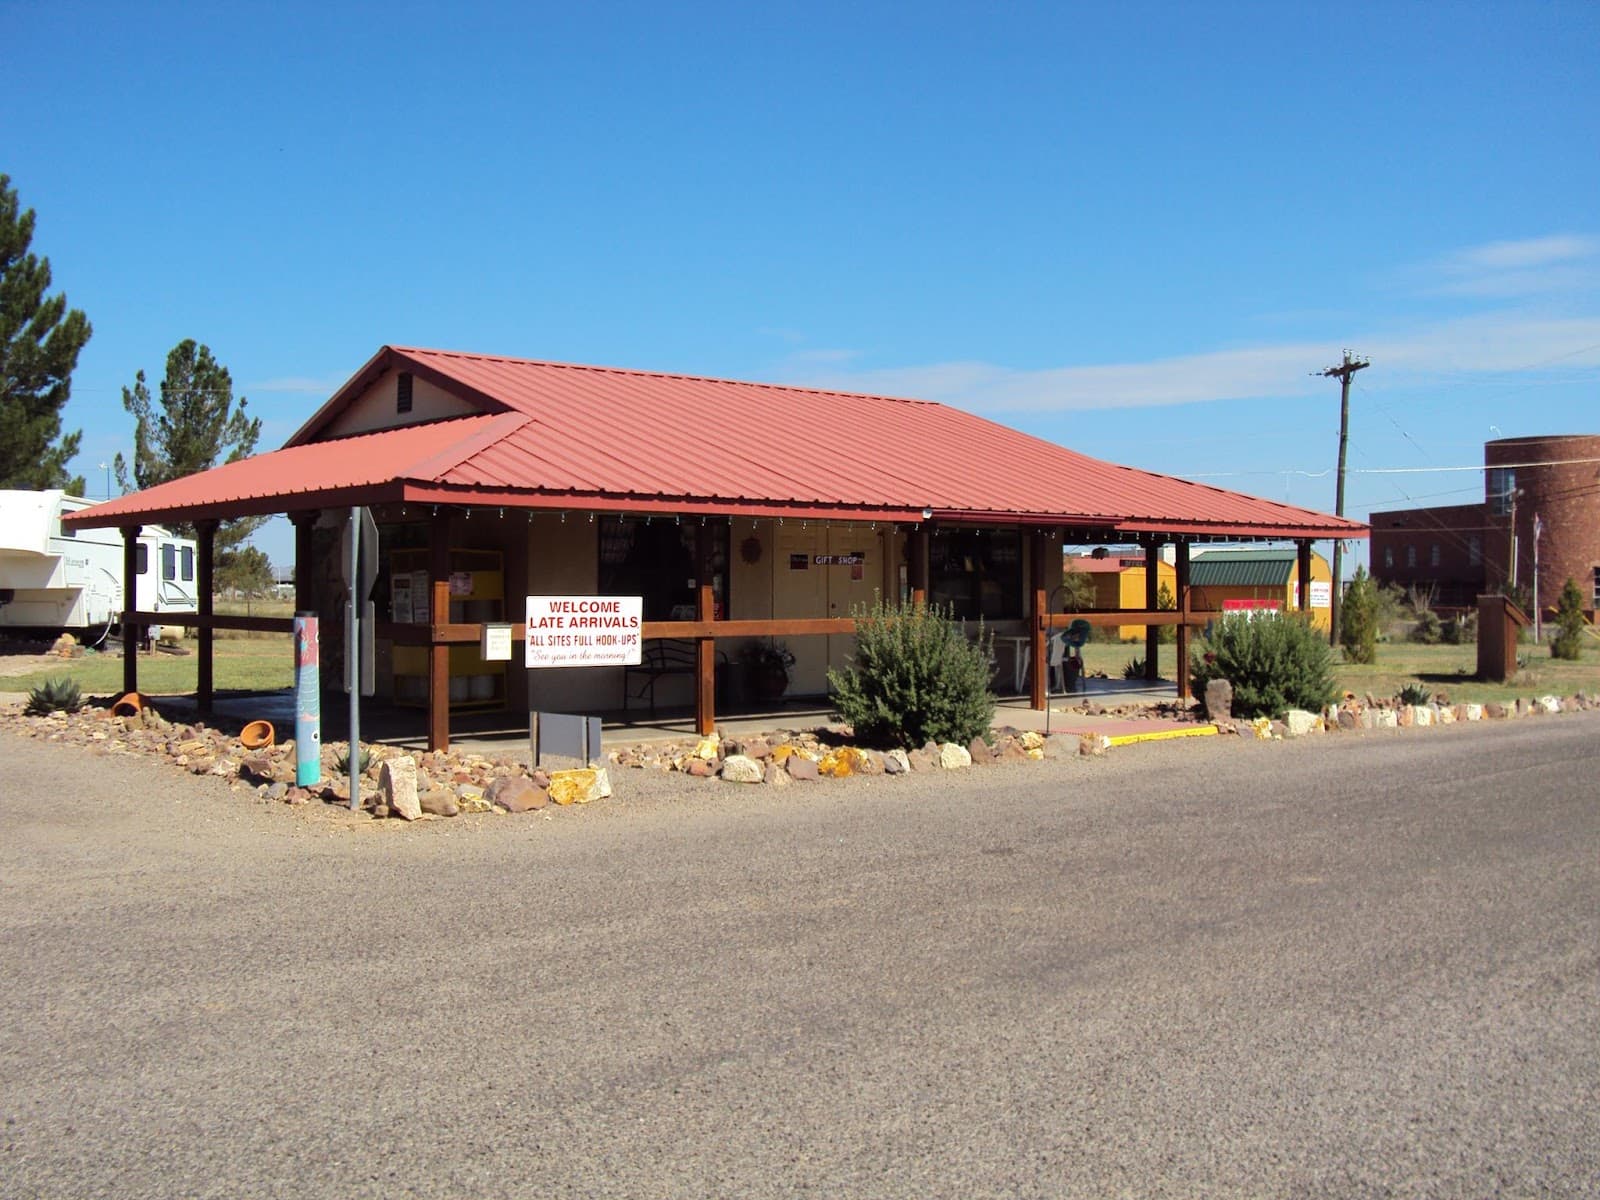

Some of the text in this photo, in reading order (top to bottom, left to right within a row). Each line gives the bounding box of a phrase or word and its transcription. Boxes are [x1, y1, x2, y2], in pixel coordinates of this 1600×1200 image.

[815, 556, 857, 564] GIFT SHOP
[549, 601, 621, 613] WELCOME
[530, 616, 638, 628] LATE ARRIVALS
[530, 634, 637, 646] ALL SITES FULL HOOK-UPS
[551, 654, 566, 664] you
[568, 652, 576, 660] in
[579, 649, 592, 660] the
